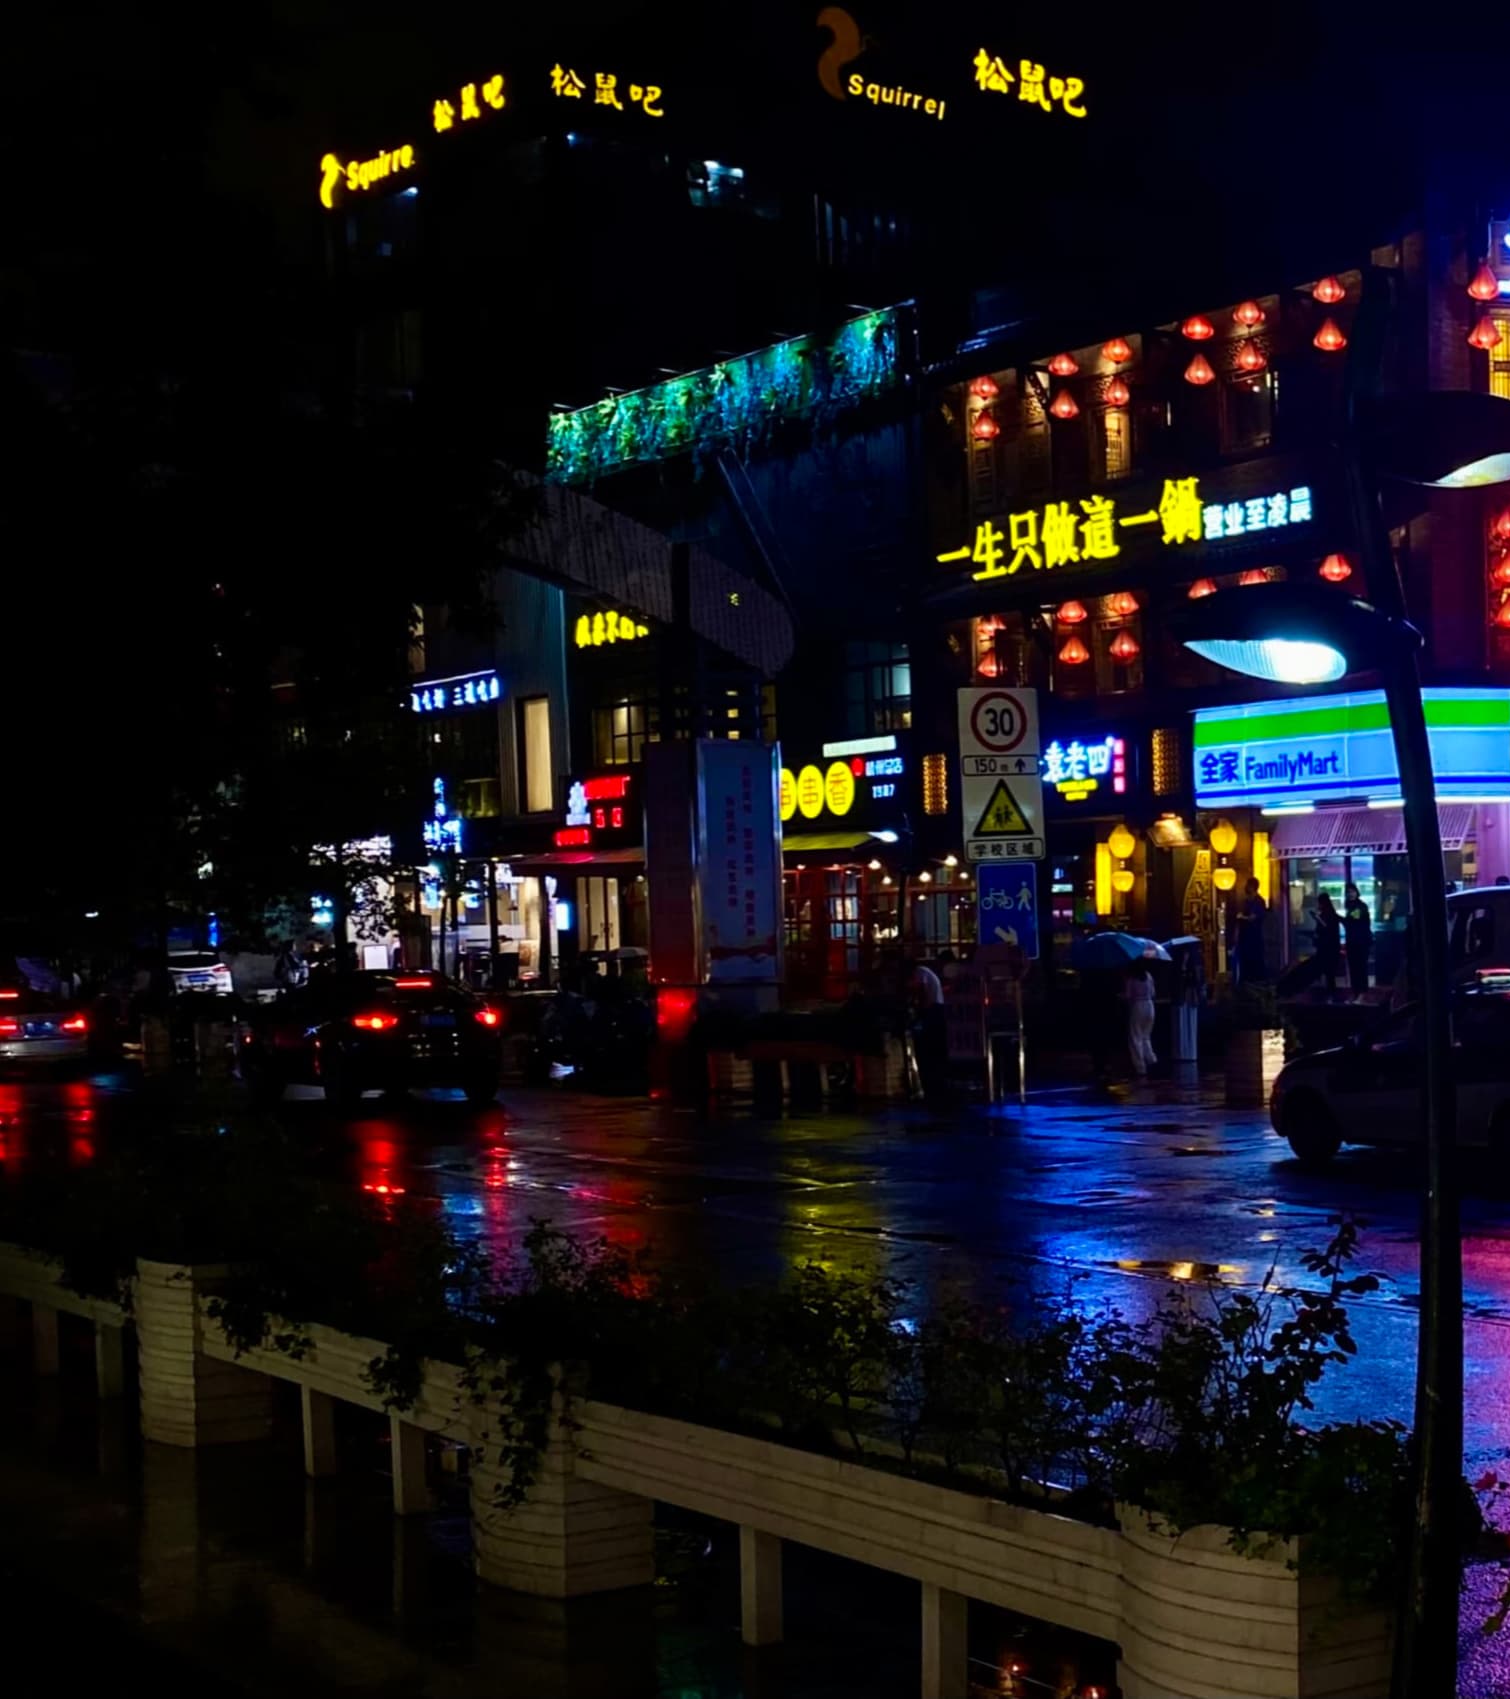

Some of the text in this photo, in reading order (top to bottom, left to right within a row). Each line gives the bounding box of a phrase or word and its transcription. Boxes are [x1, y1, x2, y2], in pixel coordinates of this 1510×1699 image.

[550, 63, 664, 117] 松鼠吧
[848, 74, 945, 120] Squirrel
[974, 48, 1087, 117] 松鼠吧
[1203, 486, 1312, 540] 营业至凌晨
[984, 707, 1015, 737] 30
[974, 758, 997, 773] 150
[1042, 739, 1112, 783] 袁老四
[1200, 751, 1339, 785] 全家 FamilyMart
[973, 841, 1035, 857] 学校区域
